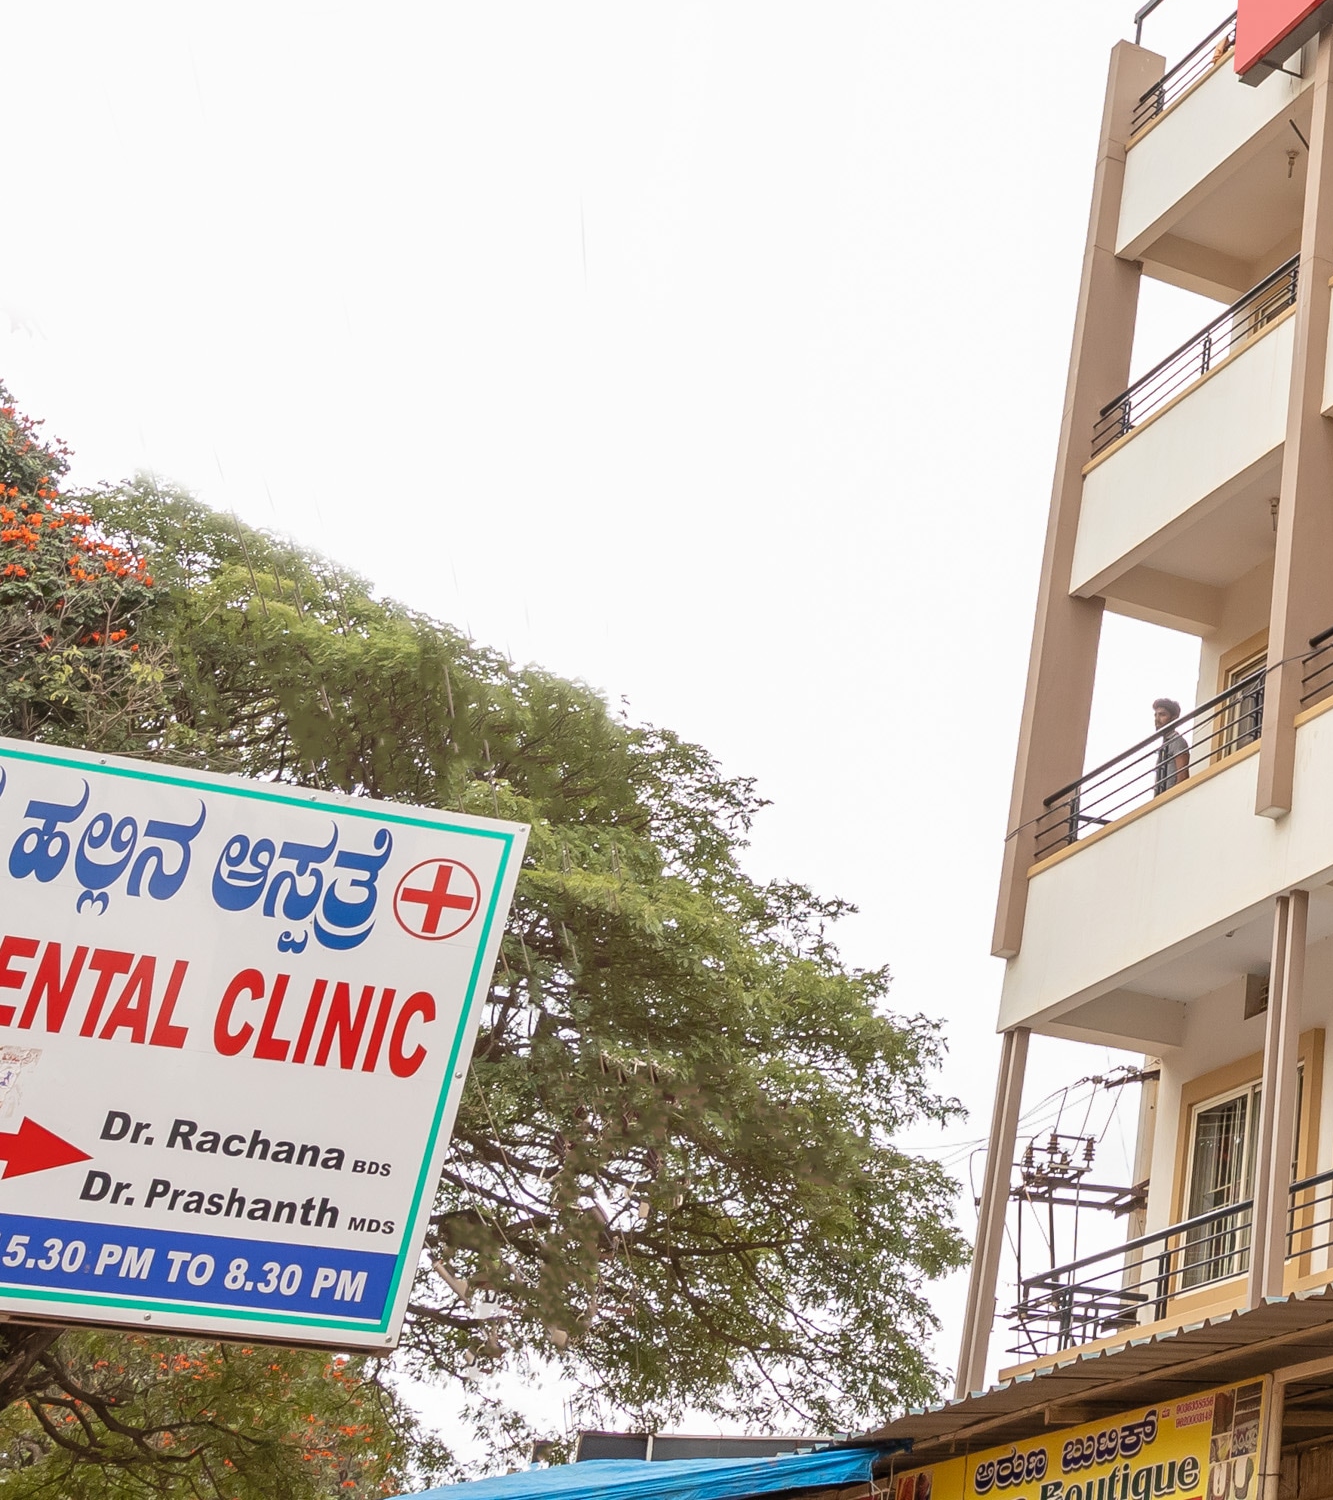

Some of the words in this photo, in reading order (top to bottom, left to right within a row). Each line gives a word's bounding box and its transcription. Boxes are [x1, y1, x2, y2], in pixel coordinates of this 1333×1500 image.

[8, 778, 206, 916] ಹಲ್ಲಿನ
[212, 820, 393, 954] ಆಸ್ಪತ್ರೆ
[213, 968, 436, 1078] CLINIC
[100, 1110, 154, 1145] Dr.
[166, 1119, 346, 1170] Rachana
[351, 1160, 392, 1177] BDS
[79, 1170, 135, 1206] Dr.
[144, 1179, 339, 1228] Prashanth
[347, 1217, 395, 1234] MDS
[2, 1235, 86, 1273] 5.30
[94, 1244, 155, 1279] PM
[167, 1251, 215, 1286] TO
[223, 1258, 302, 1296] 8.30
[310, 1268, 368, 1302] PM
[1040, 1456, 1200, 1500] Boutique
